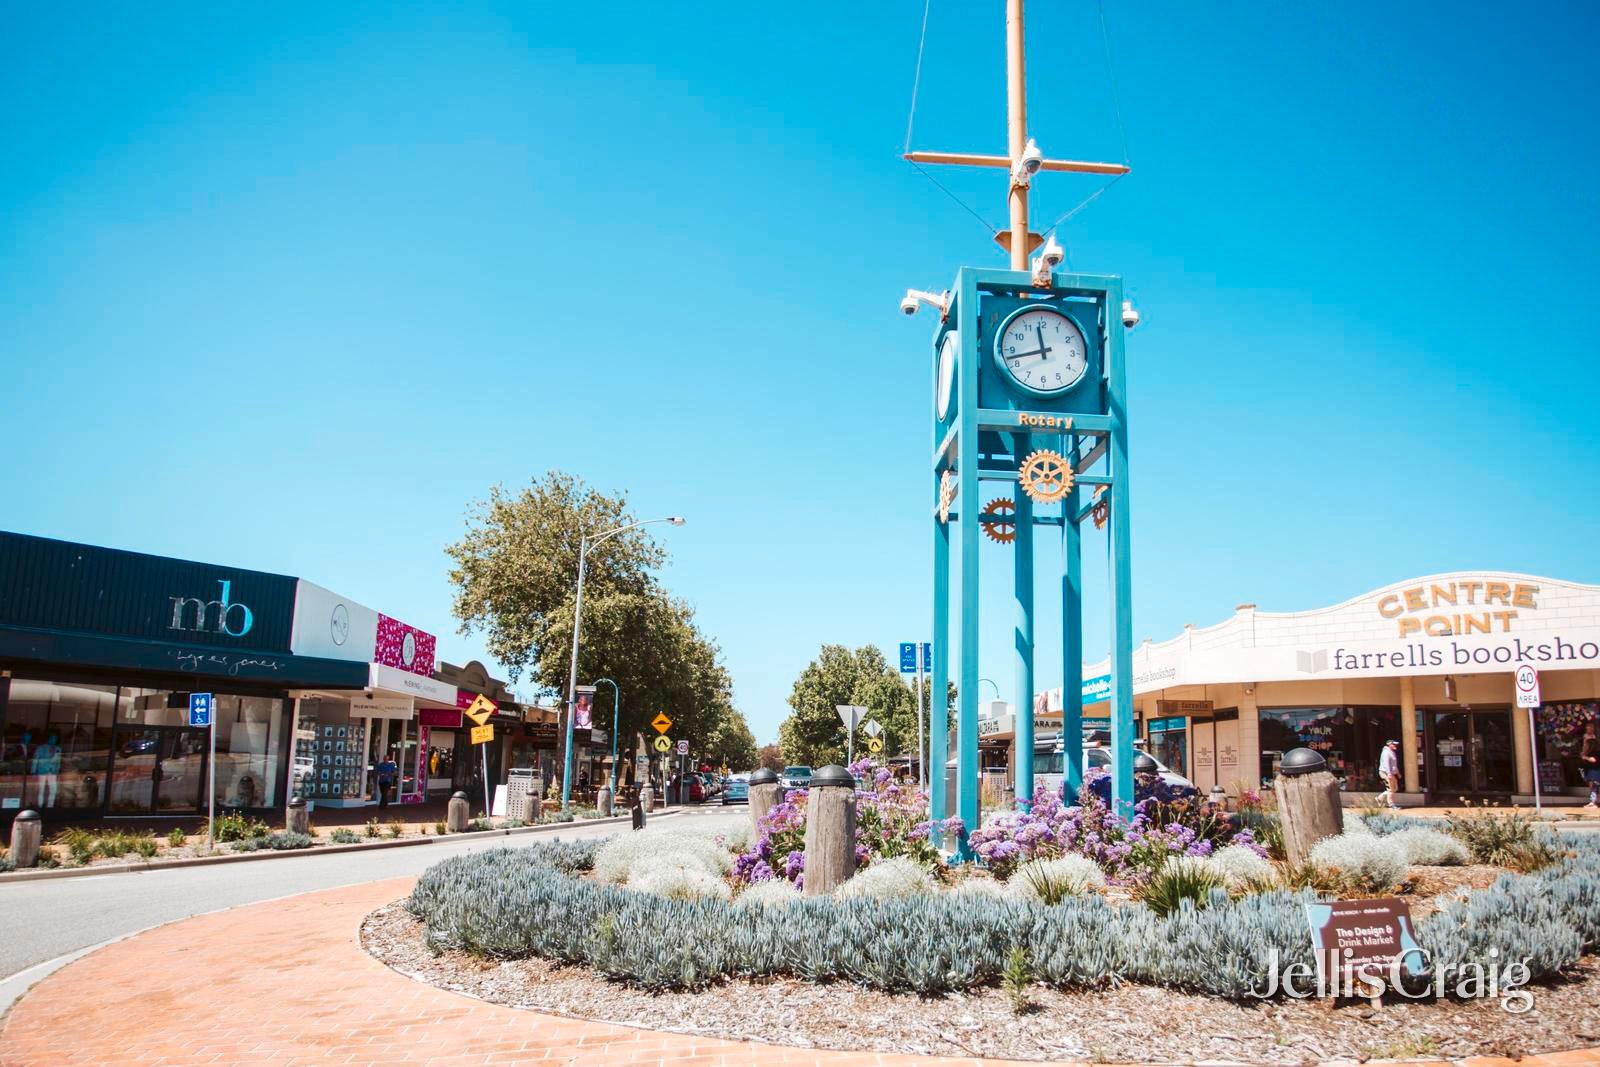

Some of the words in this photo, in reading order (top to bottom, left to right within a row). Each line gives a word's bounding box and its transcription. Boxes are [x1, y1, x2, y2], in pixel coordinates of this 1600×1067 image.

[1024, 323, 1033, 332] 11
[1038, 321, 1047, 330] 12
[1015, 333, 1025, 342] 10
[1065, 335, 1071, 344] 2
[1009, 346, 1016, 355] 9
[1070, 349, 1076, 358] 3
[1014, 359, 1020, 368] 8
[1066, 363, 1072, 371] 4
[1026, 370, 1032, 379] 7
[1056, 372, 1062, 381] 5
[1041, 375, 1047, 384] 6
[1018, 413, 1073, 428] Rotary
[1377, 581, 1540, 619] CENTRE
[1398, 611, 1519, 639] POINT
[905, 645, 912, 654] P
[1334, 644, 1443, 671] farrells
[1520, 672, 1534, 684] 40
[1519, 695, 1538, 704] AREA
[1308, 726, 1333, 736] YOUR
[1308, 741, 1334, 751] SHOP
[1335, 928, 1354, 939] The
[1354, 926, 1385, 938] Design
[1386, 924, 1393, 935] &
[1338, 937, 1362, 948] Drink
[1363, 935, 1395, 946] Market
